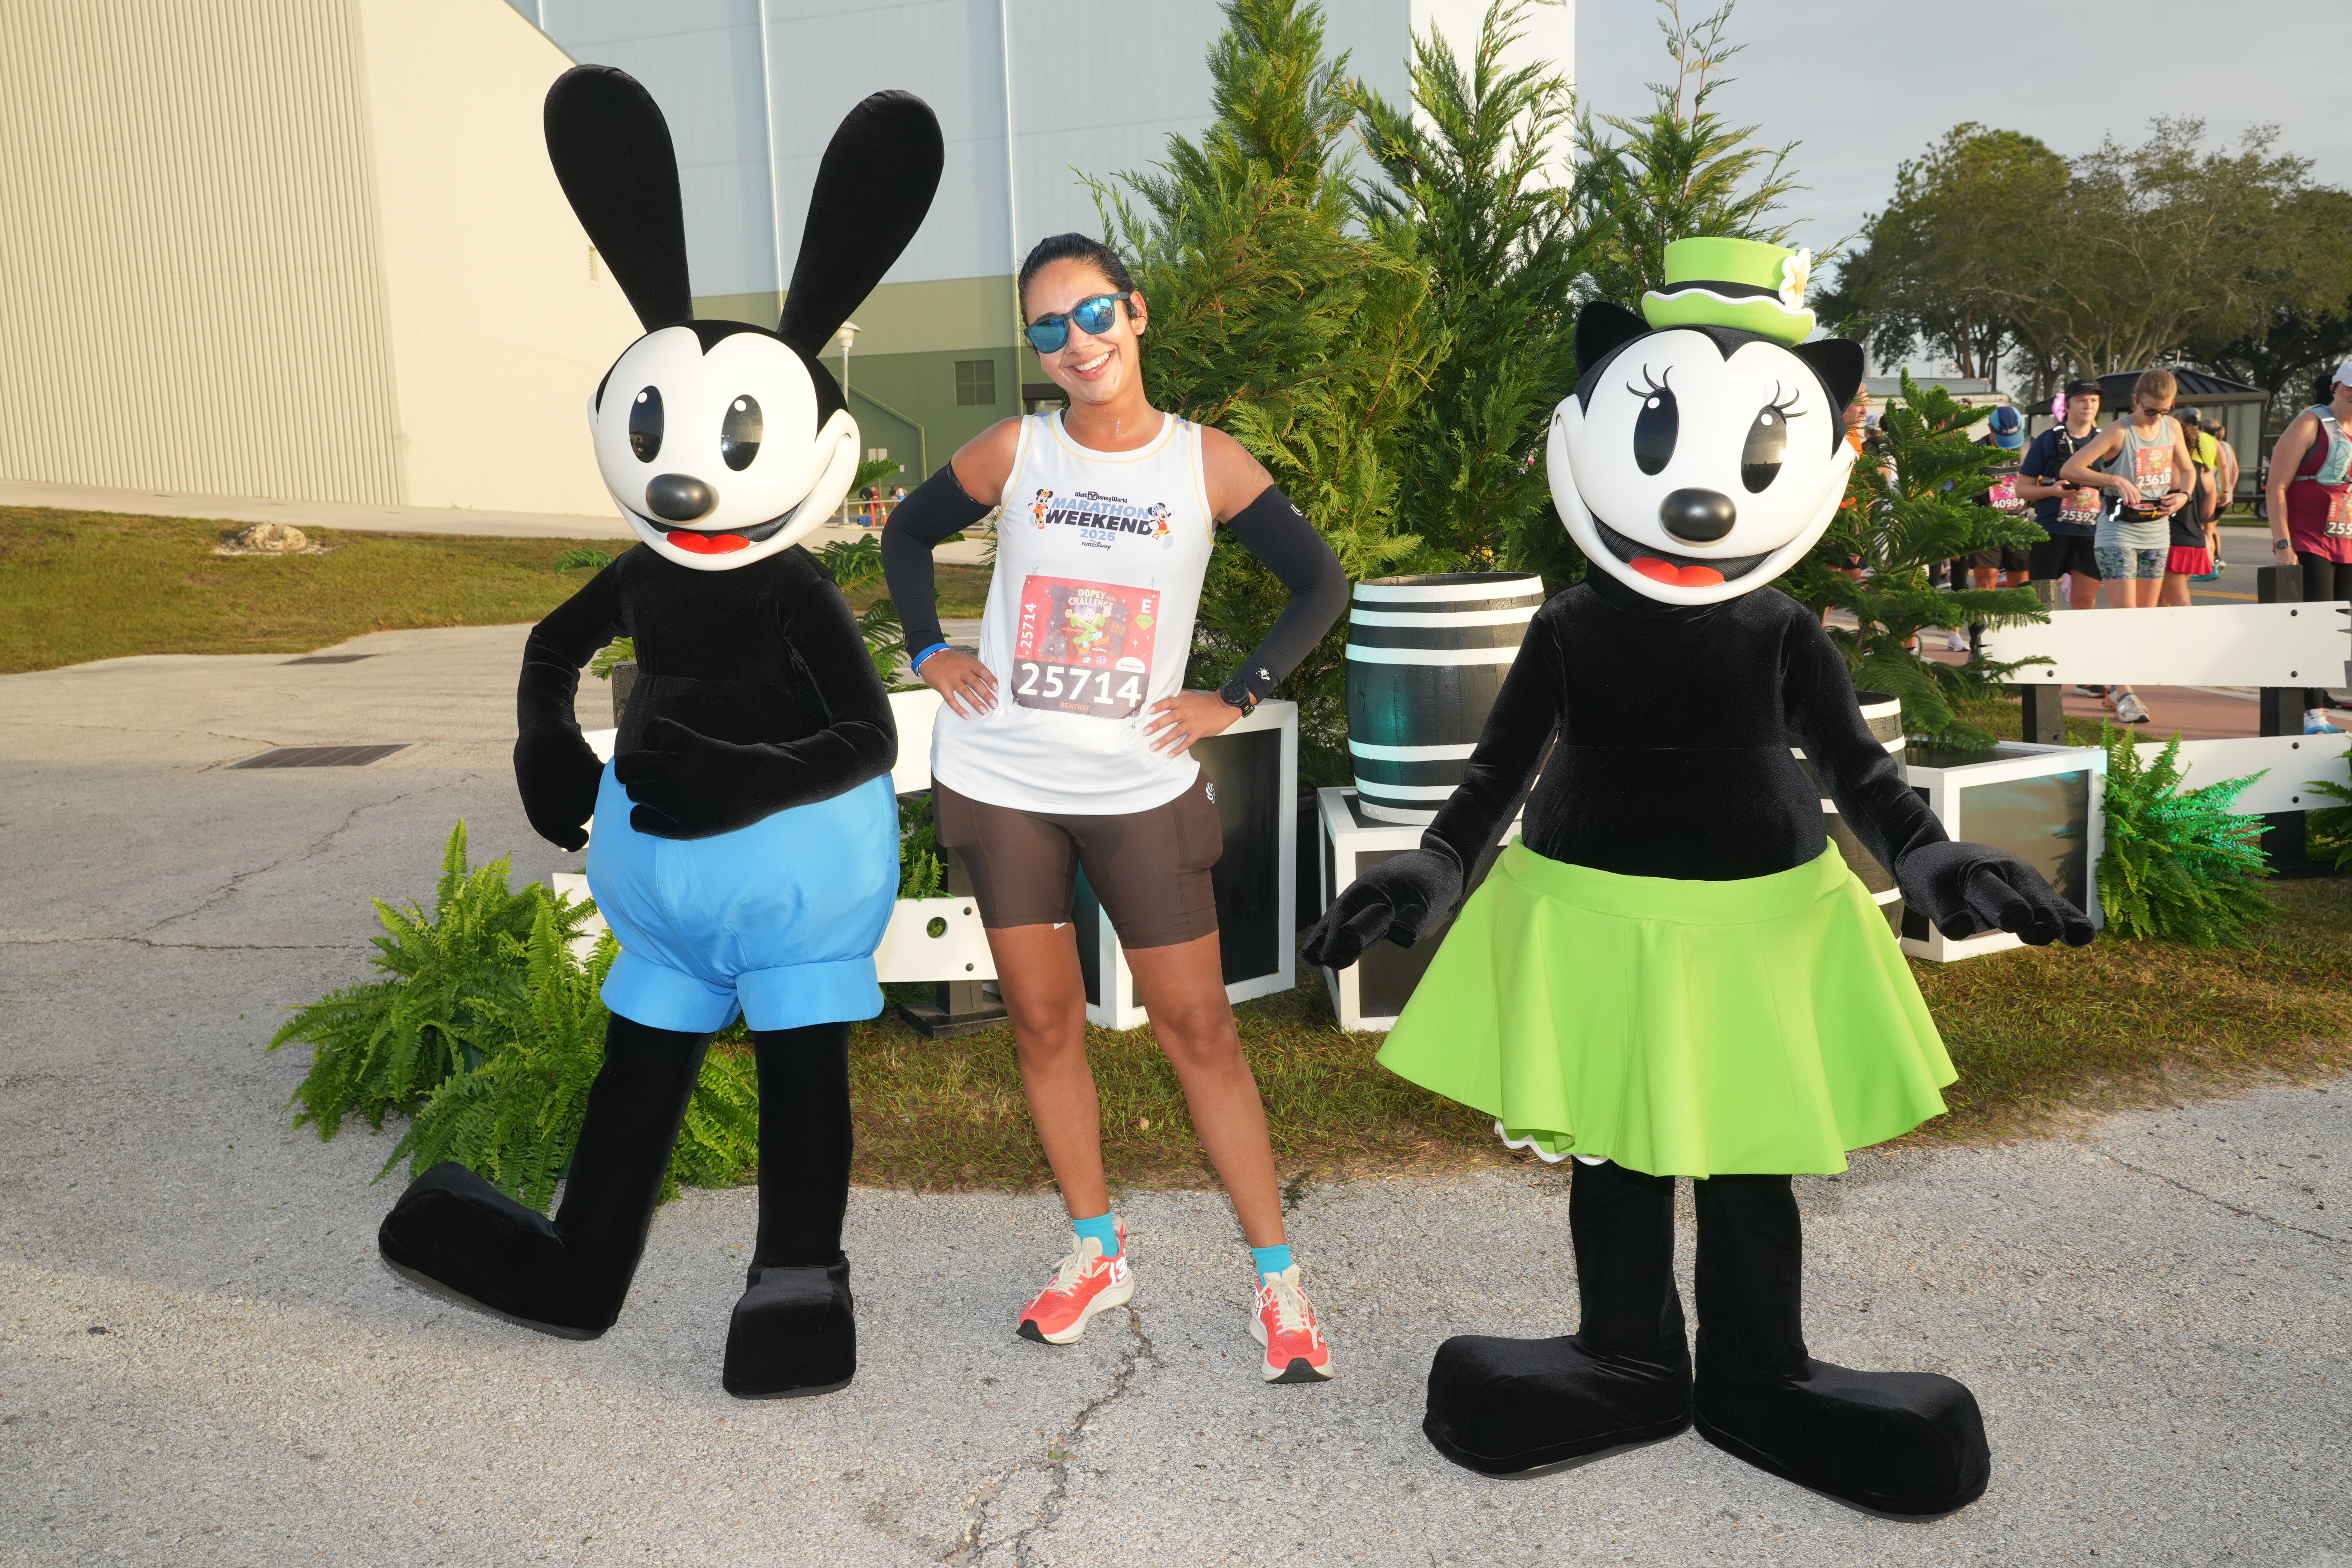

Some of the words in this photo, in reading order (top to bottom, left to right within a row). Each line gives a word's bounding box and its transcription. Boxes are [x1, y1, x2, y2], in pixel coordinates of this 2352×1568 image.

[2137, 473, 2171, 486] 23610
[1087, 491, 1111, 502] Disney
[1051, 497, 1149, 520] MARATHON
[1992, 498, 2025, 509] 40984
[1046, 509, 1153, 535] WEEKEND
[2061, 510, 2097, 522] 25392
[1080, 529, 1116, 541] 2026
[1078, 589, 1106, 600] DOPEY
[1068, 597, 1114, 611] CHALLENGE
[1141, 599, 1152, 614] E
[1020, 603, 1036, 649] 25714
[1111, 622, 1126, 632] 48.6
[1018, 663, 1142, 708] 25714
[1060, 702, 1091, 711] BEATRIZ
